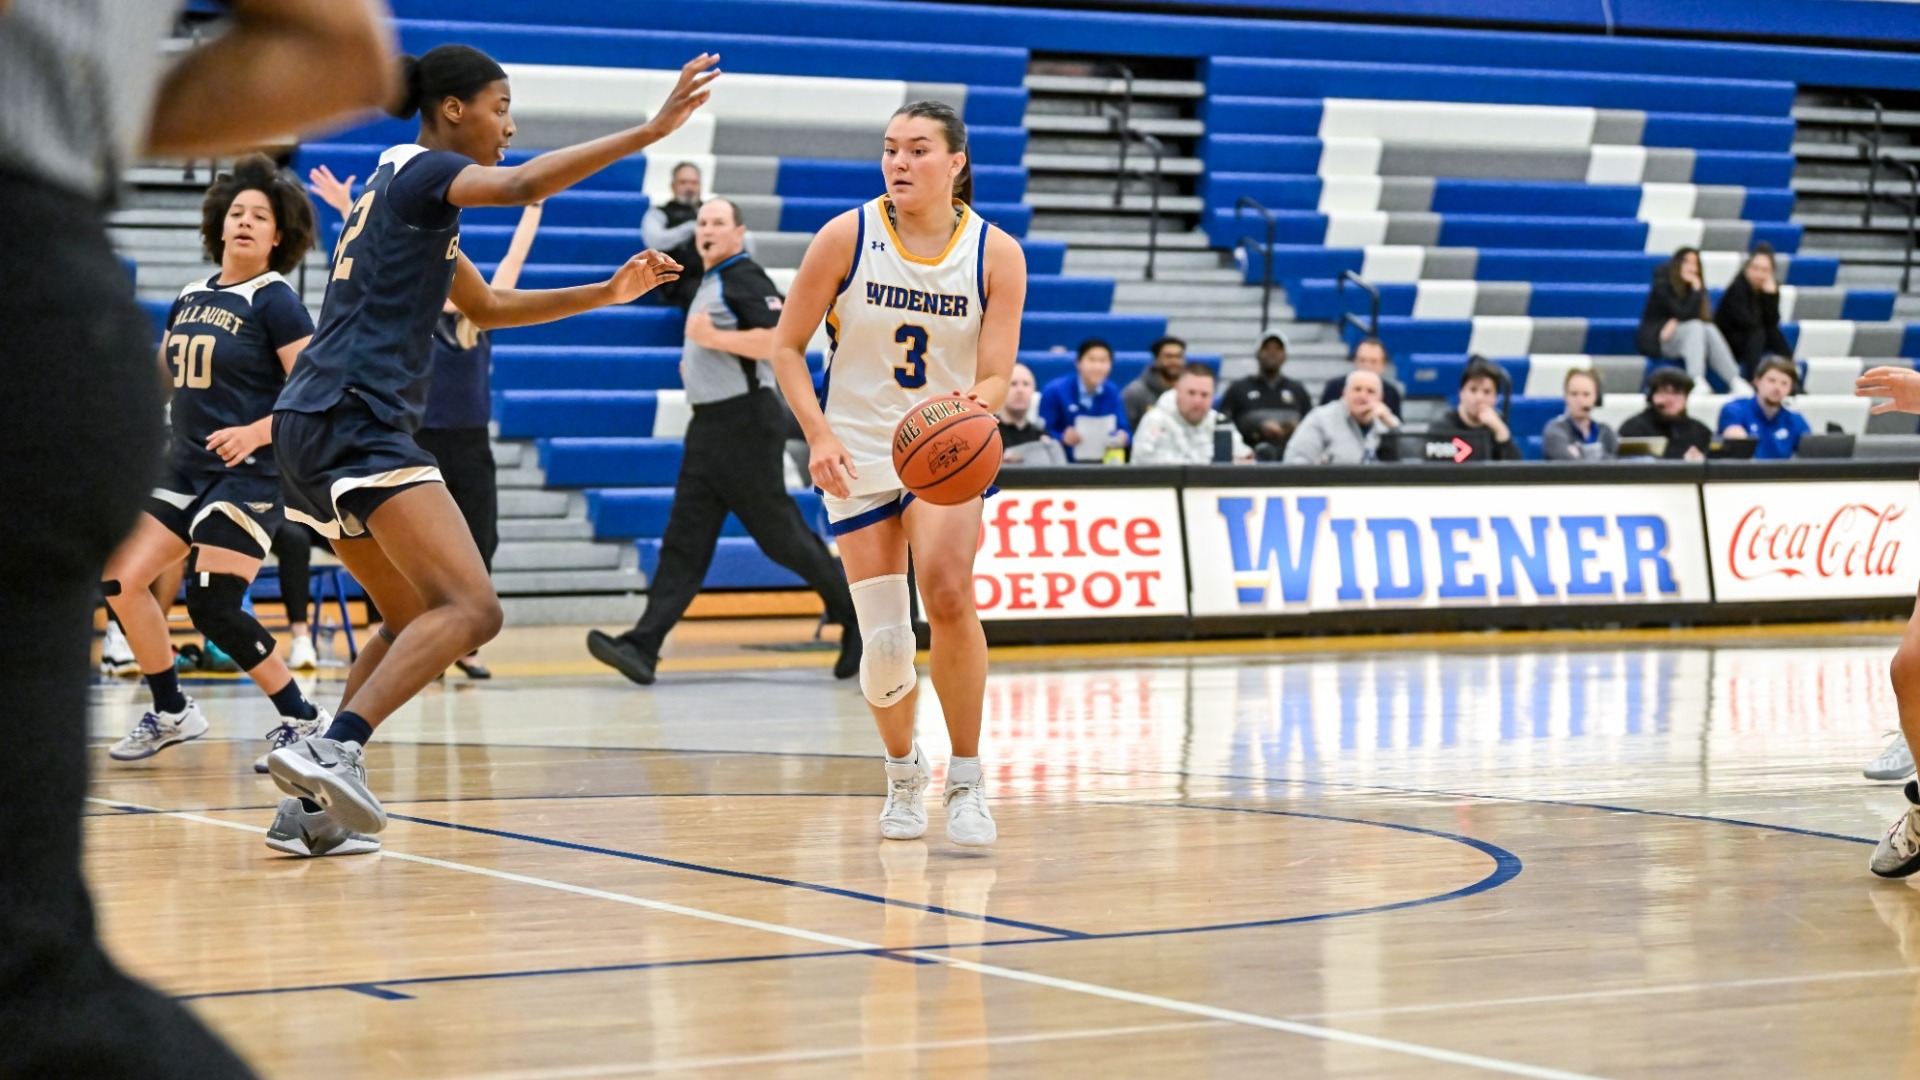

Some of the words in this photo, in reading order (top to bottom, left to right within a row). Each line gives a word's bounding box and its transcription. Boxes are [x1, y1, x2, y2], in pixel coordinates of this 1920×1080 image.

[331, 189, 377, 282] 2
[174, 305, 244, 336] ALLAUDET
[866, 281, 969, 318] WIDENER
[168, 334, 217, 390] 30
[893, 322, 930, 390] 3
[895, 417, 922, 454] THE
[920, 400, 970, 428] ROCK
[1217, 496, 1680, 605] WIDENER
[1728, 503, 1908, 581] Coca-Cola
[972, 570, 1162, 611] DEPOT
